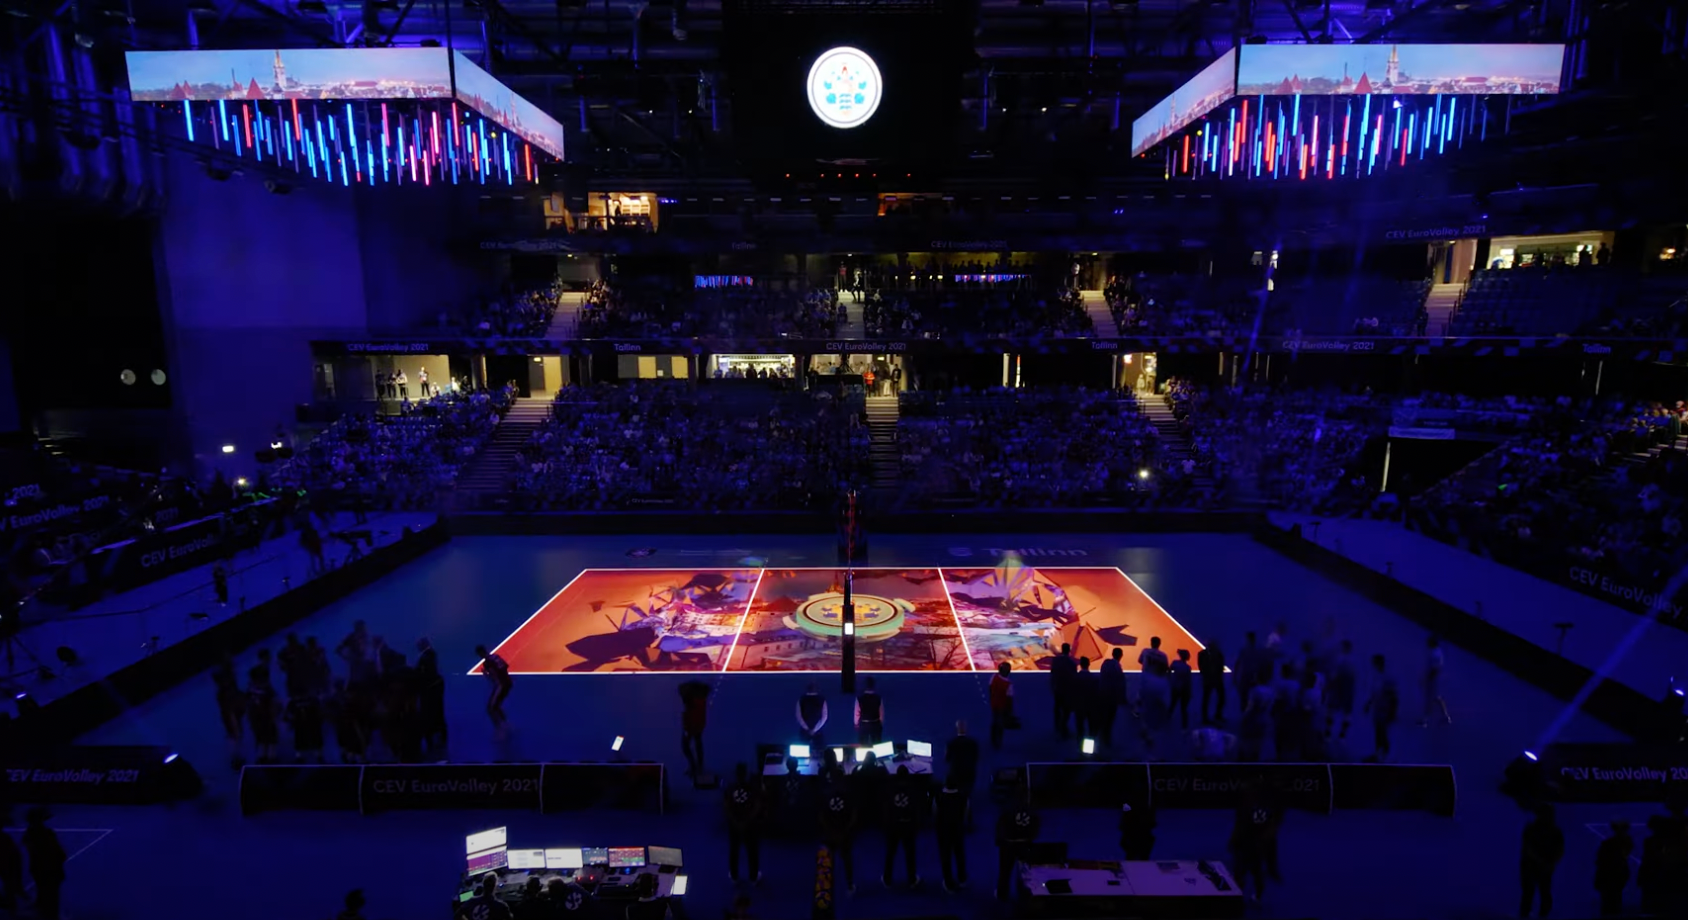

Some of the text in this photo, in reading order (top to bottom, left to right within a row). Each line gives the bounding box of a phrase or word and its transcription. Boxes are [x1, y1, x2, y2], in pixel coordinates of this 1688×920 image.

[1385, 224, 1486, 239] CEV EuroVolley 2021
[410, 343, 429, 351] 2021
[613, 343, 642, 351] Tallinn
[825, 342, 907, 351] CEV EuroVolley 2021
[1091, 341, 1118, 349] Tallinn
[1353, 341, 1375, 350] 2021
[12, 483, 40, 500] 2021
[140, 547, 166, 568] CEV
[1569, 566, 1683, 619] CEV EuroVolley
[31, 768, 104, 786] EuroVolley
[105, 768, 140, 783] 2021
[1591, 765, 1667, 784] EuroVolley
[373, 777, 539, 796] CEV EuroVolley 2021
[1153, 778, 1188, 792] CEV
